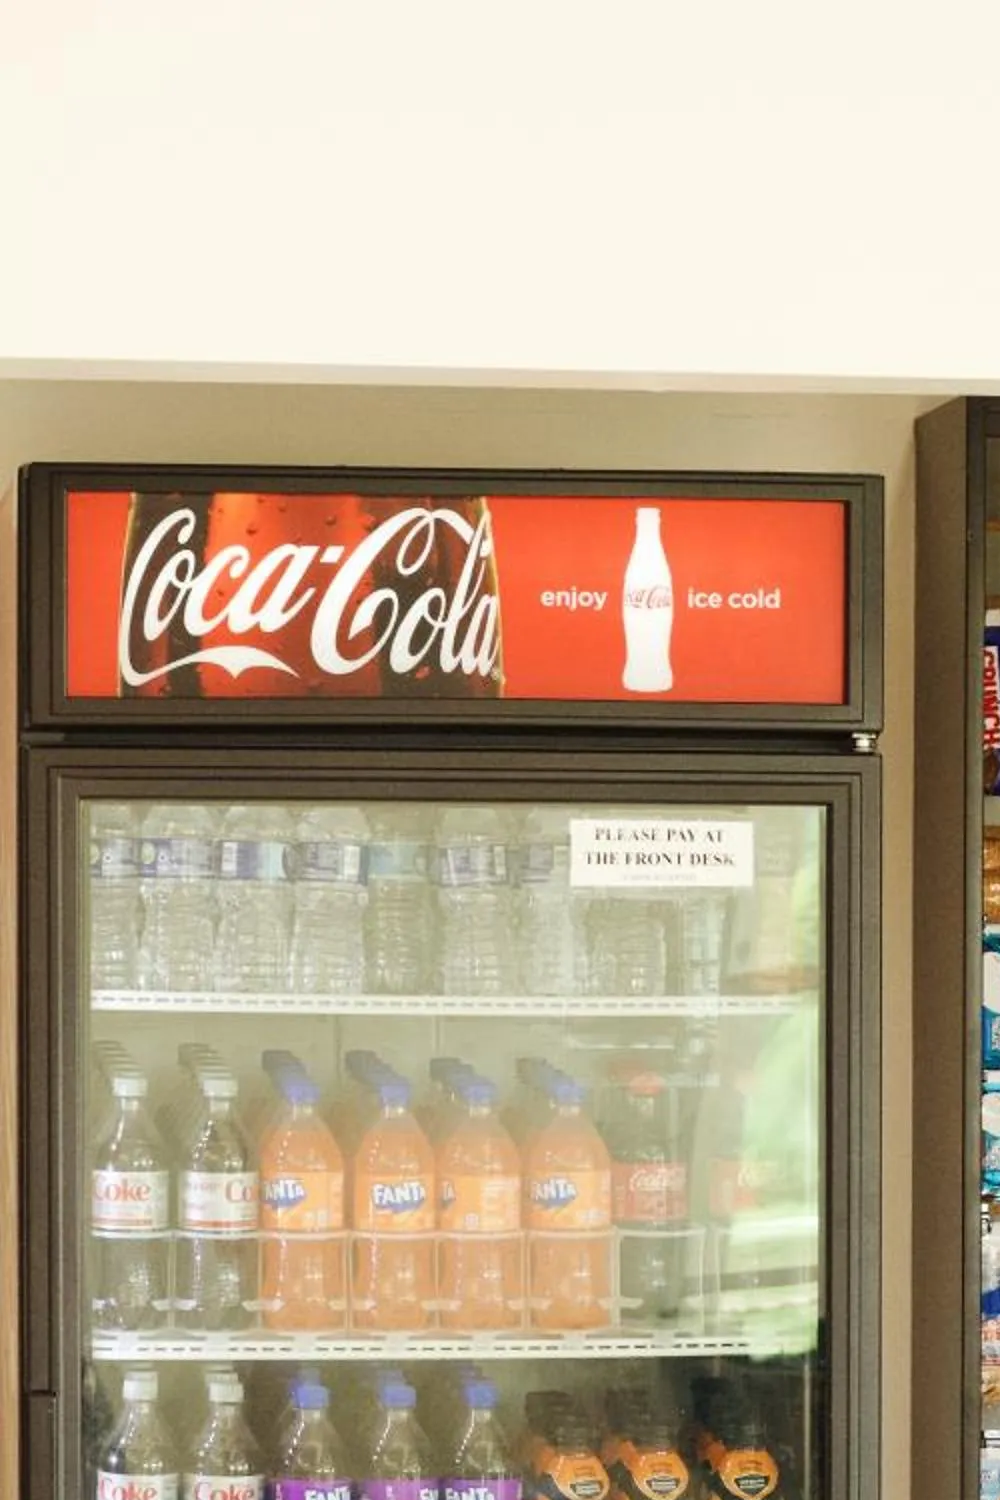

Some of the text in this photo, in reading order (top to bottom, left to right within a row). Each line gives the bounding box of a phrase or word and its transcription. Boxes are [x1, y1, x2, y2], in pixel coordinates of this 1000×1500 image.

[118, 506, 502, 687] Coca-Cola
[540, 586, 608, 611] enjoy
[687, 586, 782, 609] ice cold
[595, 828, 724, 842] PLEASE PAY AT
[587, 852, 736, 866] THE FRONT DESK
[225, 1178, 260, 1204] Co
